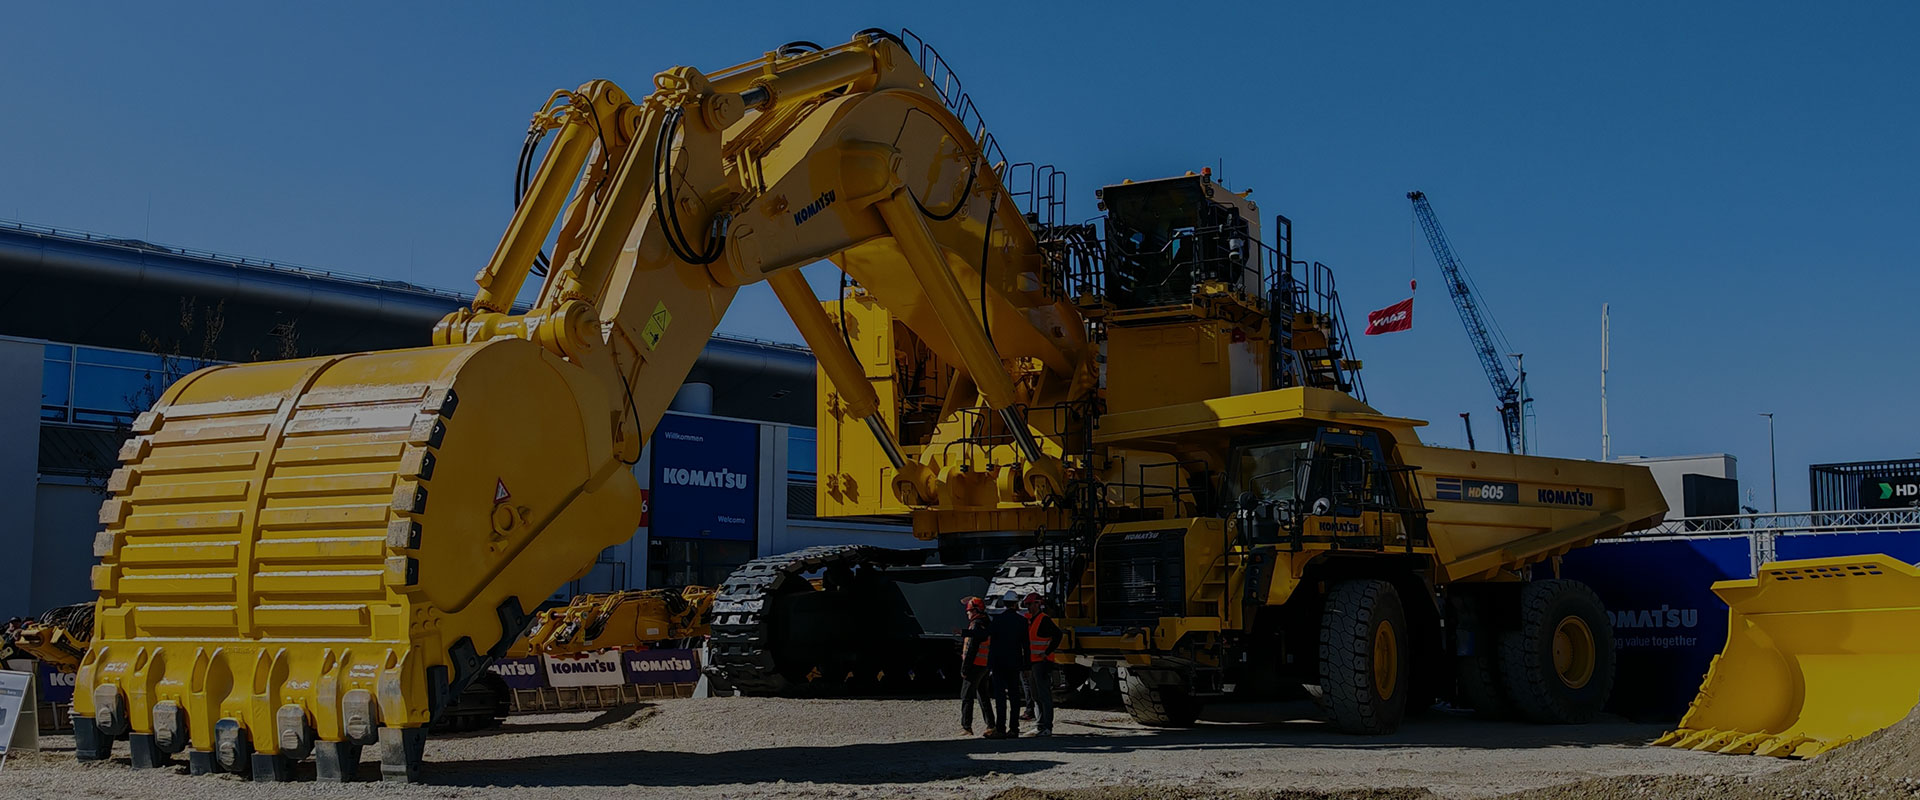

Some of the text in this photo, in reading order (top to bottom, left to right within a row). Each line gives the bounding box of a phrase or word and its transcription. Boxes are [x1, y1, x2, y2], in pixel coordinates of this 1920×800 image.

[794, 189, 836, 226] KOMATSU
[664, 431, 704, 443] Willkommen
[663, 467, 748, 490] KOMATSU
[1467, 484, 1504, 501] HD605
[1537, 488, 1594, 507] KOMATSU
[1895, 484, 1920, 497] HD
[717, 515, 746, 525] Welcome
[1319, 520, 1360, 533] KOMATSU
[1625, 635, 1650, 647] value
[1651, 635, 1697, 649] together
[551, 659, 616, 675] KOMATSU
[630, 656, 692, 673] KOMATSU
